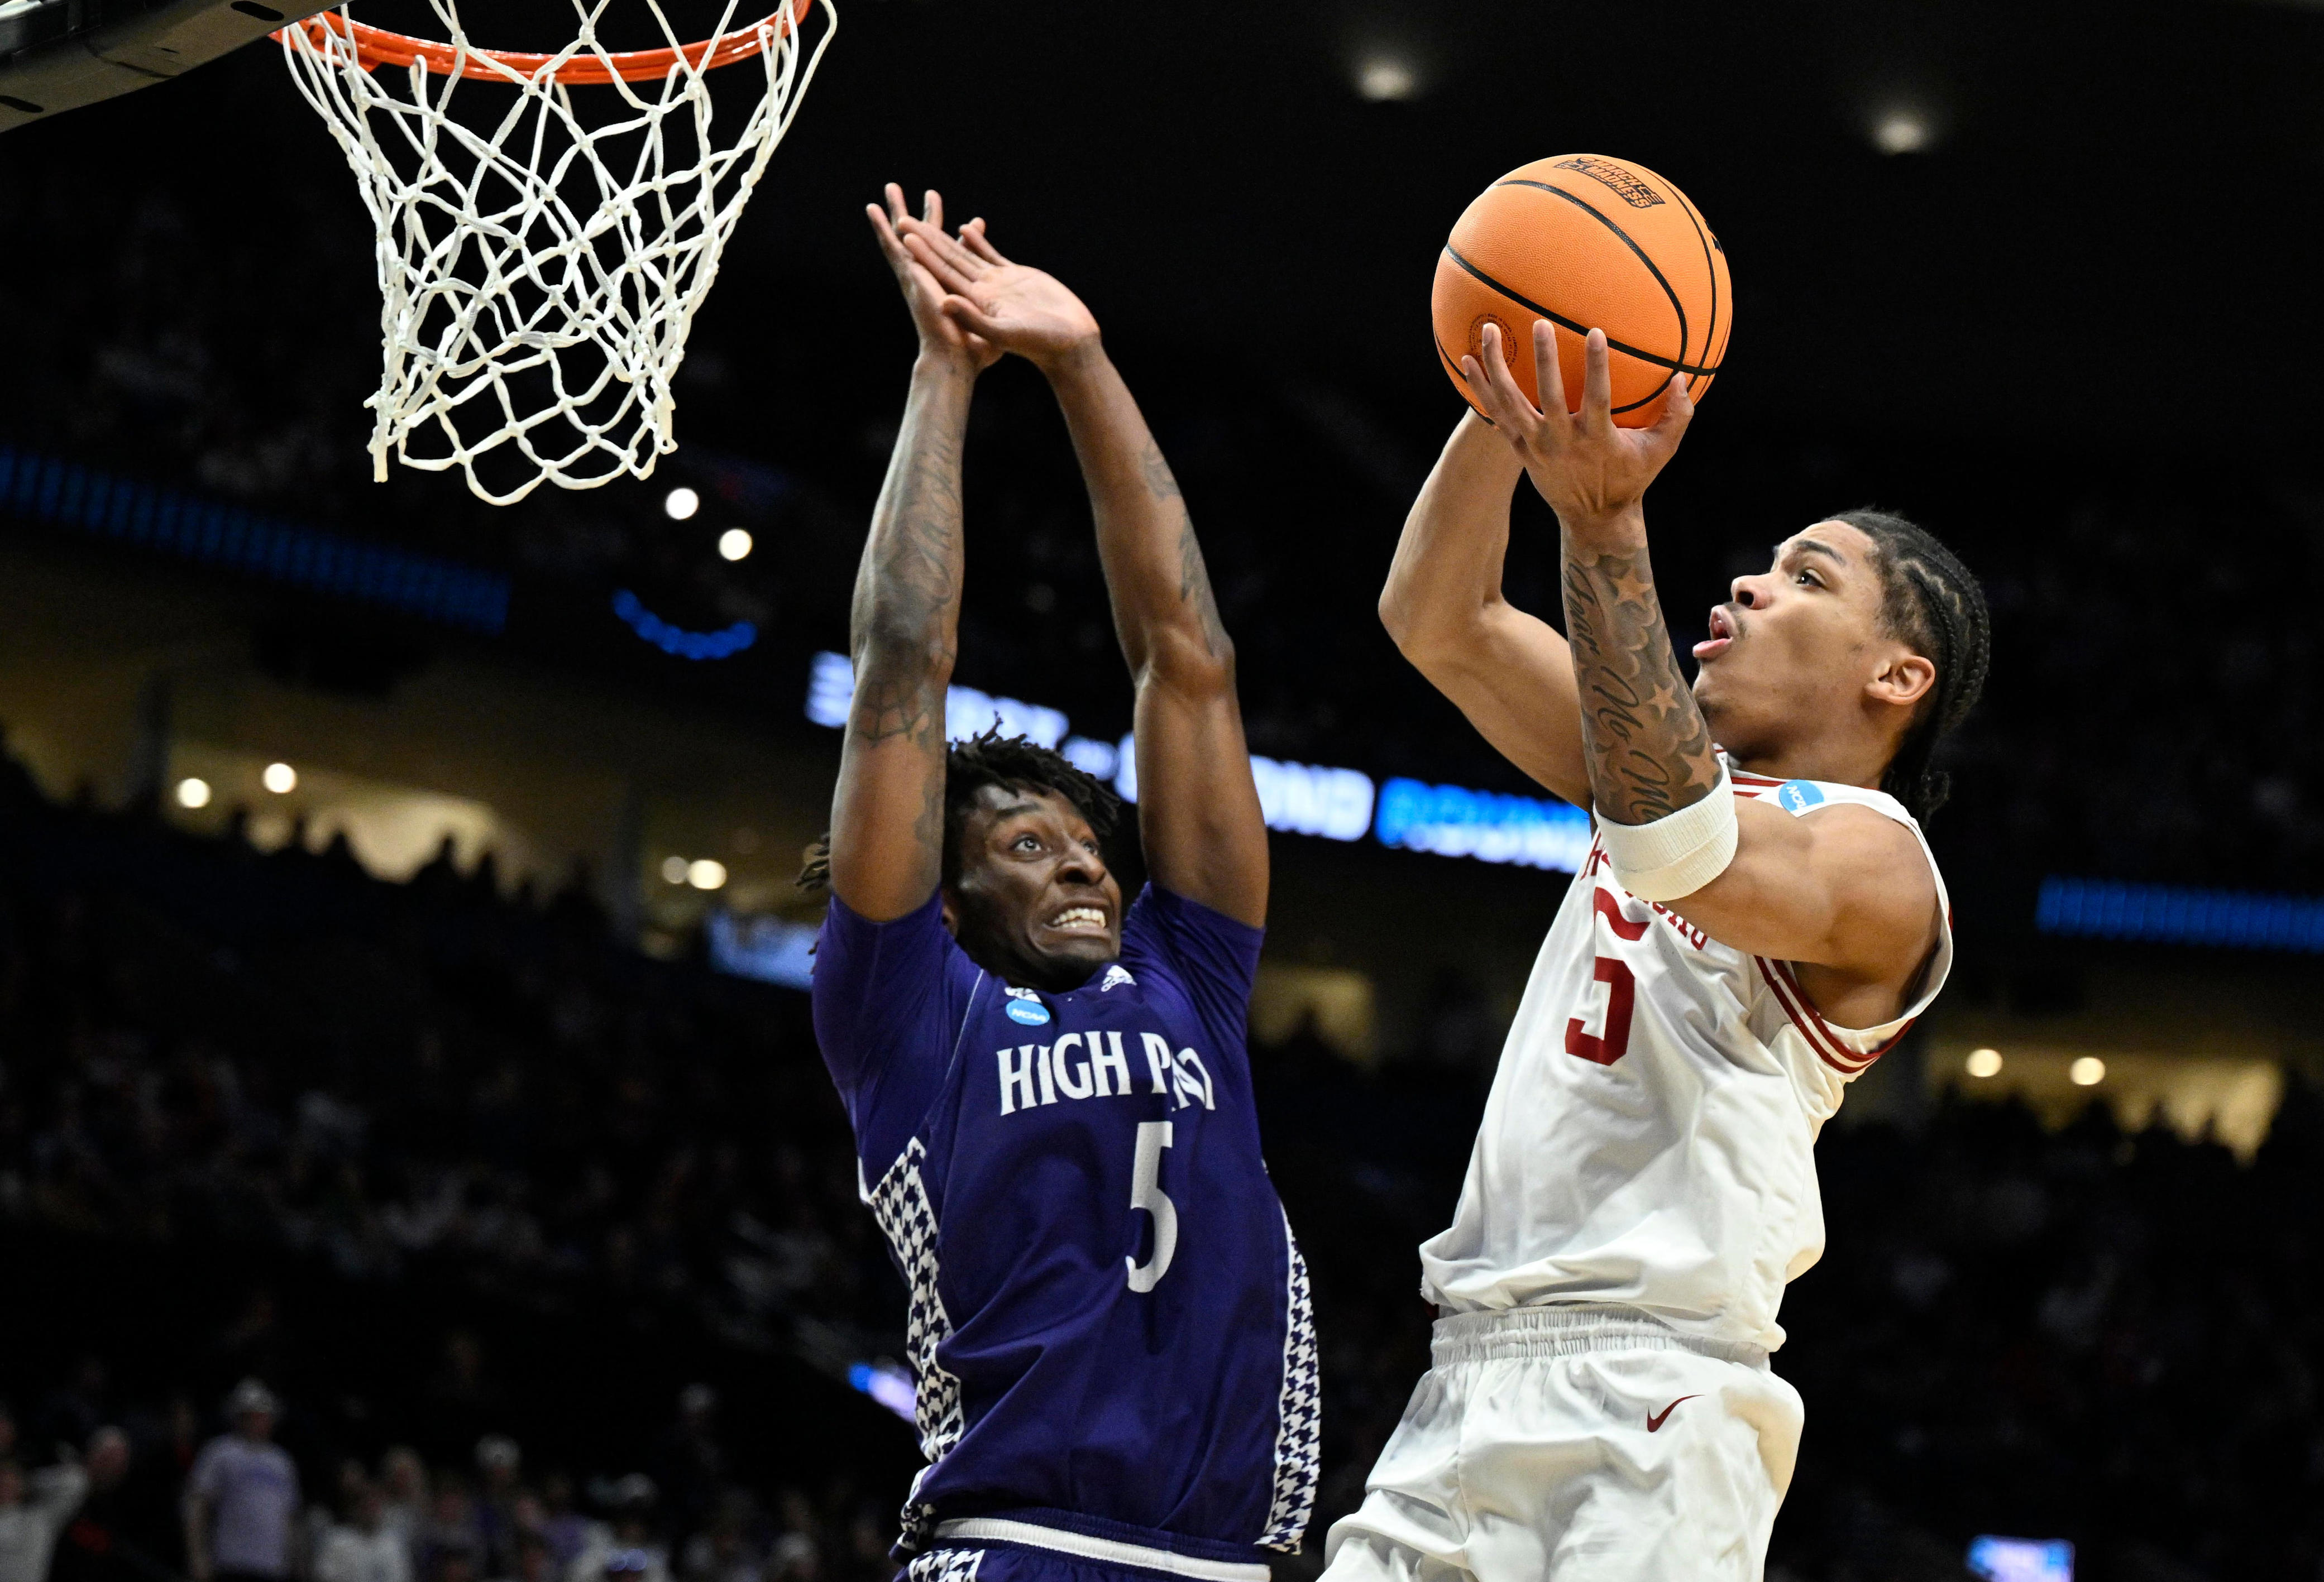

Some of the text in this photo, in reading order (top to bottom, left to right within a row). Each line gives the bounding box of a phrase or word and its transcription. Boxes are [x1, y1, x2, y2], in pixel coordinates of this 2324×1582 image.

[1585, 166, 1652, 208] MADNESS
[1589, 160, 1643, 186] MARCH
[1592, 666, 1644, 744] No
[996, 1030, 1132, 1116] HIGH
[1125, 1121, 1178, 1293] 5
